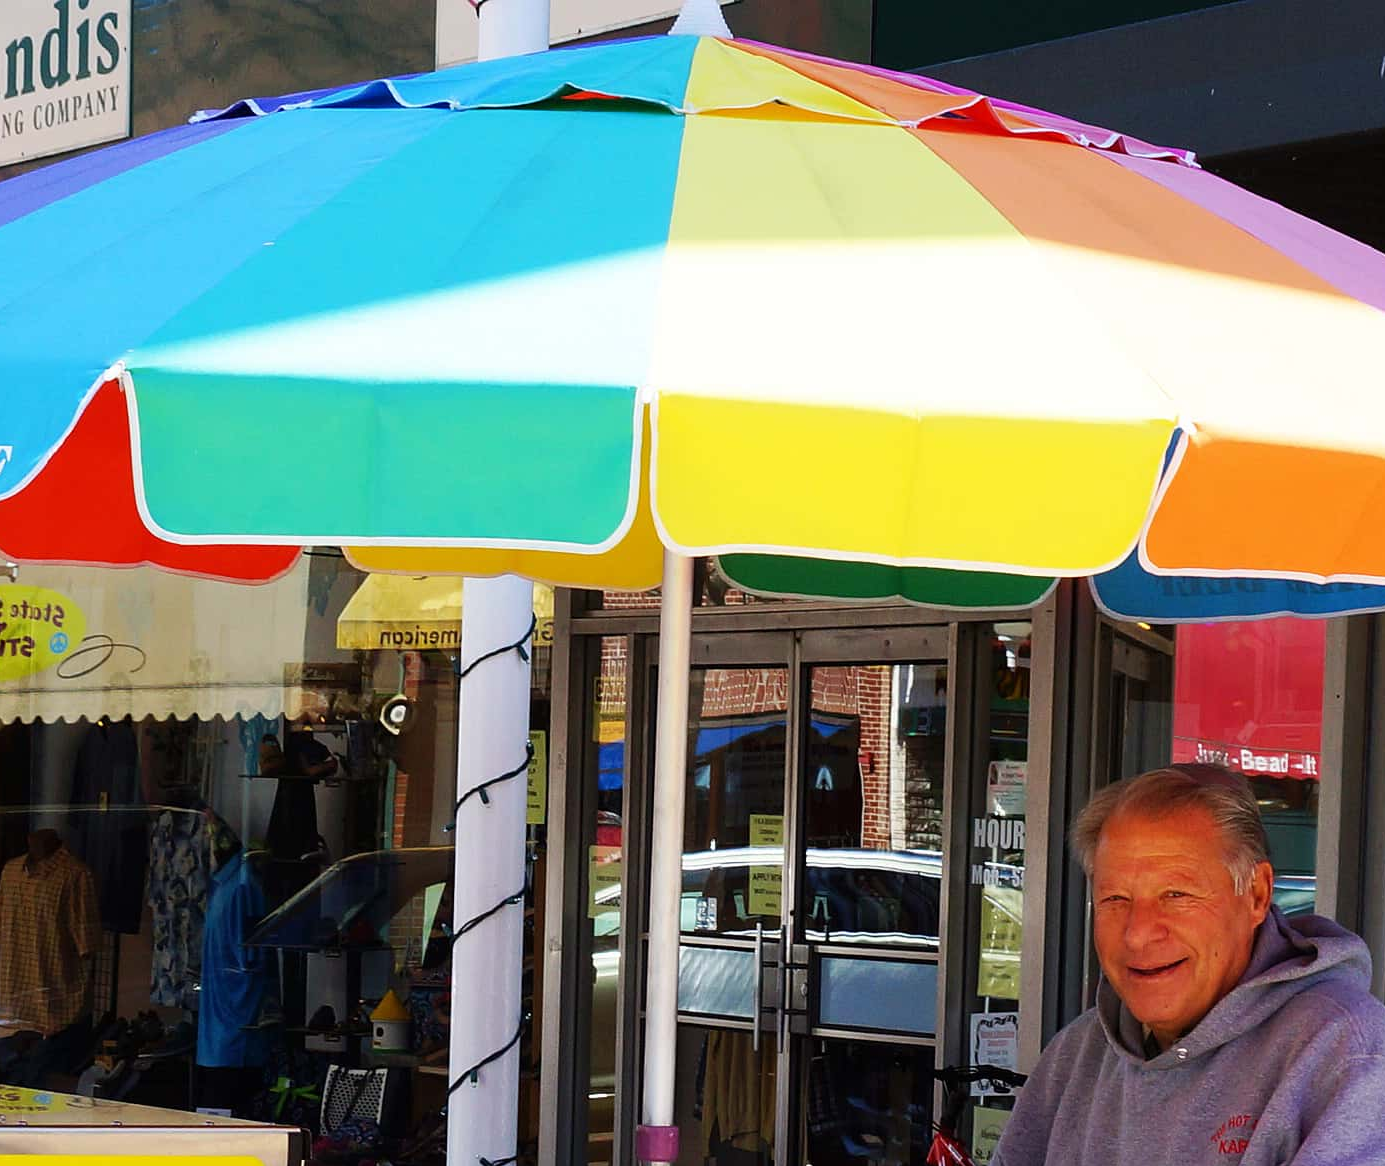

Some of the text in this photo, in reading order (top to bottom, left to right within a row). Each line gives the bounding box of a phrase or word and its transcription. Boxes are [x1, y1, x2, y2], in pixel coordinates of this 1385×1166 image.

[33, 85, 120, 130] COMPANY
[974, 818, 1026, 849] HOUR
[1228, 1115, 1251, 1127] HOT
[1219, 1140, 1250, 1154] KAR
